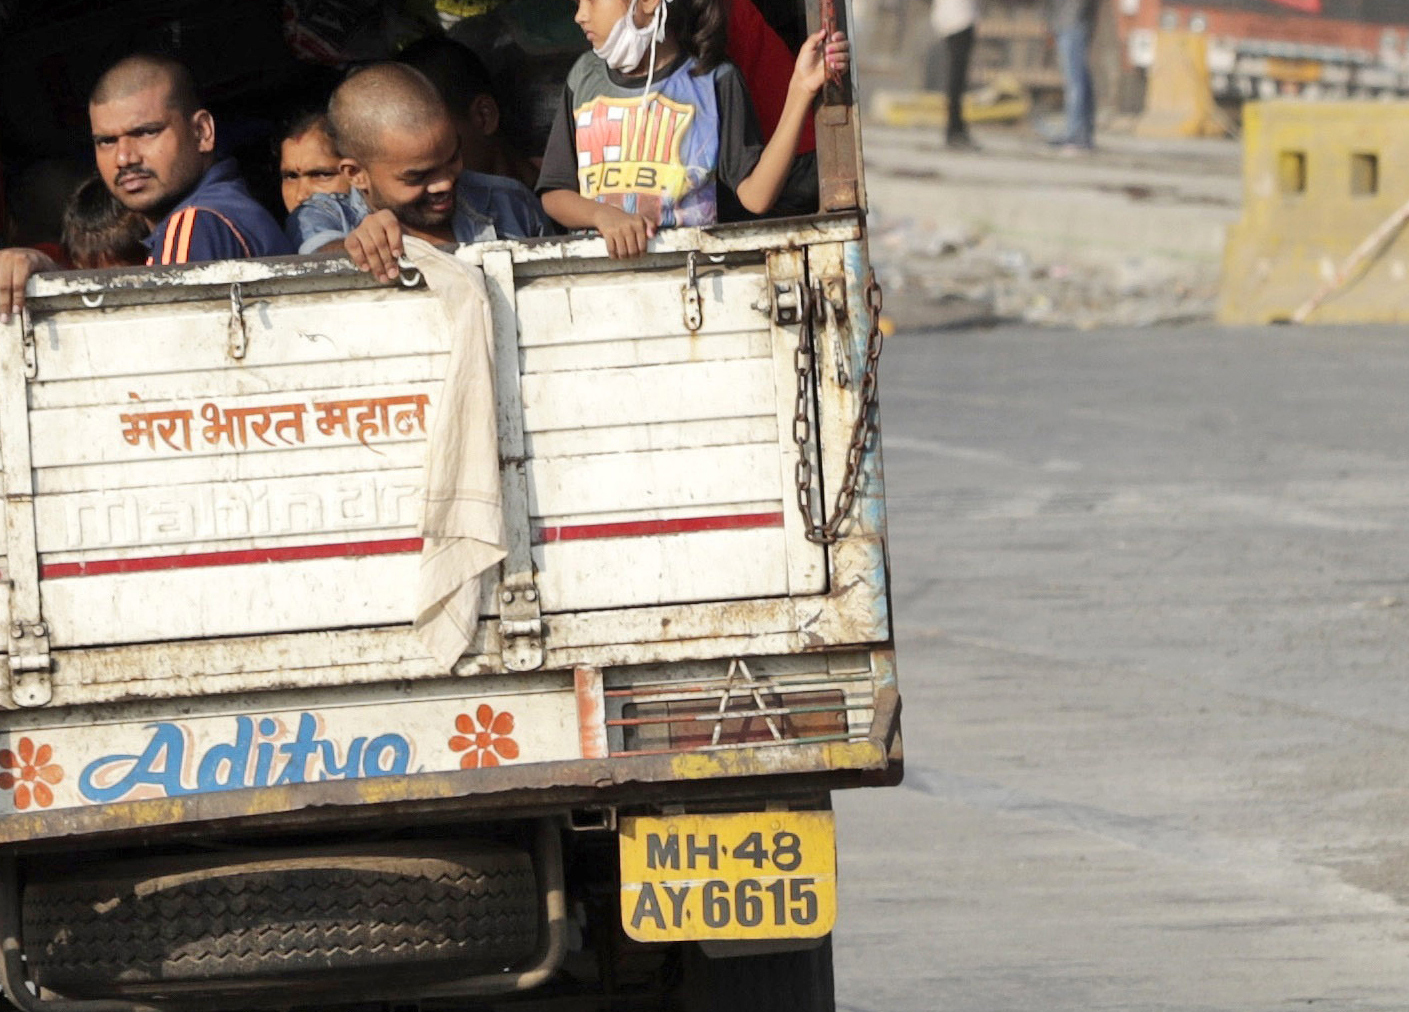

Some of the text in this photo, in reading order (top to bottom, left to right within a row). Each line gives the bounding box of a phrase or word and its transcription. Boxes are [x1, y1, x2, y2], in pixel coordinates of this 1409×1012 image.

[199, 402, 308, 451] भारत
[67, 478, 425, 548] mahindr
[78, 711, 425, 804] Aditya
